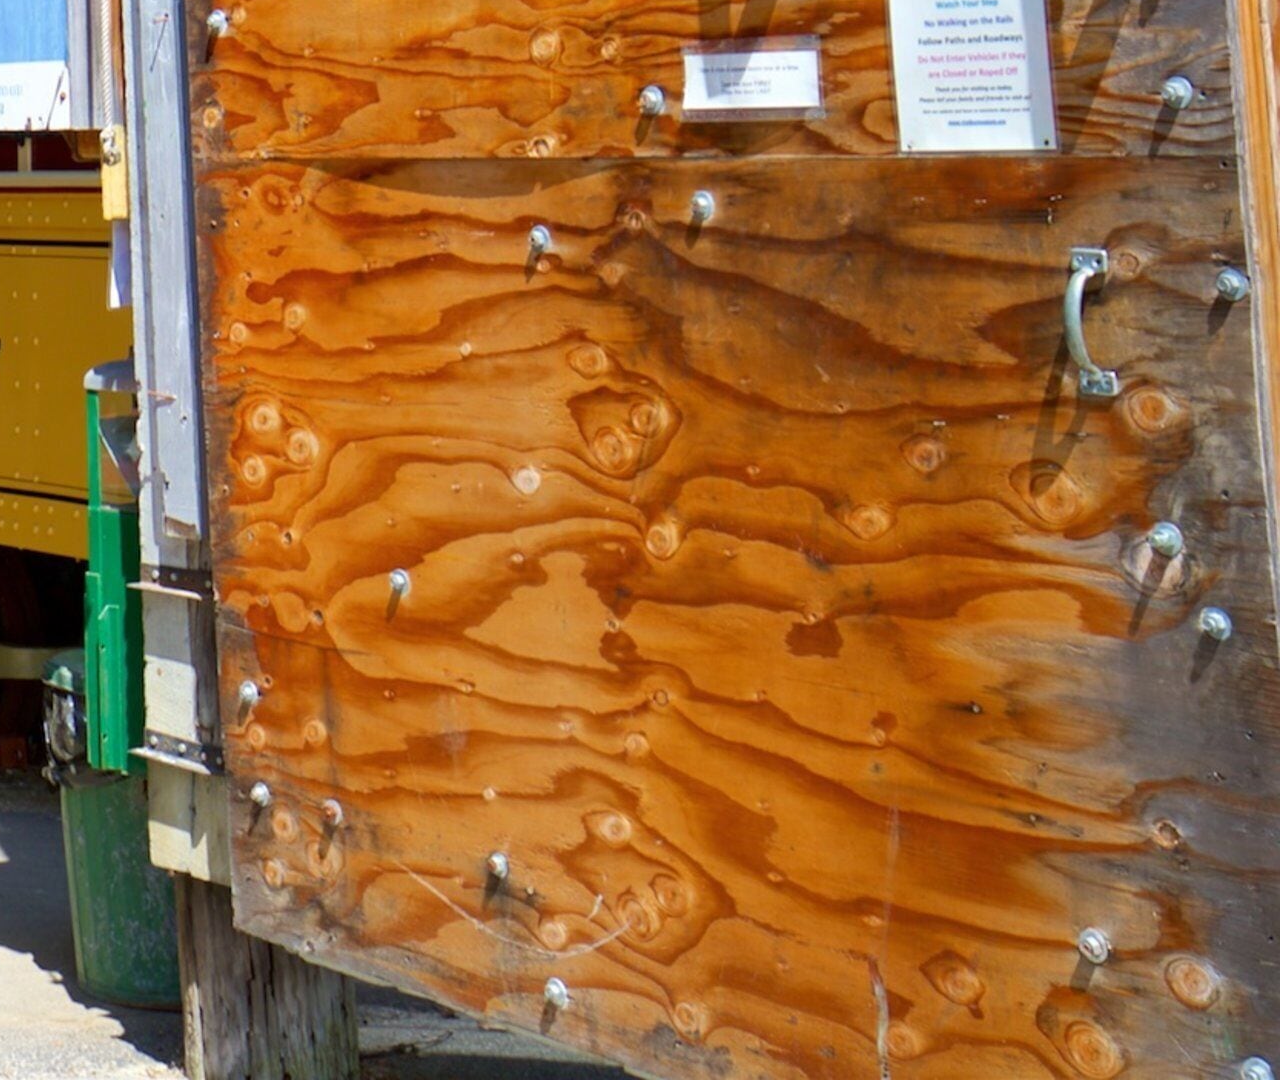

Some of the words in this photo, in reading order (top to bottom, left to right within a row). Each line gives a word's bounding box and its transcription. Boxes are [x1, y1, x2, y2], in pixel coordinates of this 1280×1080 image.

[935, 0, 960, 9] Watch
[962, 0, 979, 8] Your
[924, 19, 935, 27] No
[937, 17, 967, 27] Walking
[980, 16, 993, 24] the
[995, 15, 1014, 23] Rails
[918, 37, 943, 45] Follow
[944, 36, 966, 44] Paths
[967, 35, 982, 43] and
[984, 33, 1023, 43] Roadways
[918, 55, 929, 64] Do
[930, 55, 945, 63] Not
[946, 54, 966, 62] Enter
[968, 53, 1000, 62] Vehicles
[1008, 51, 1026, 61] they
[942, 68, 967, 77] Closed
[979, 68, 1003, 77] Roped
